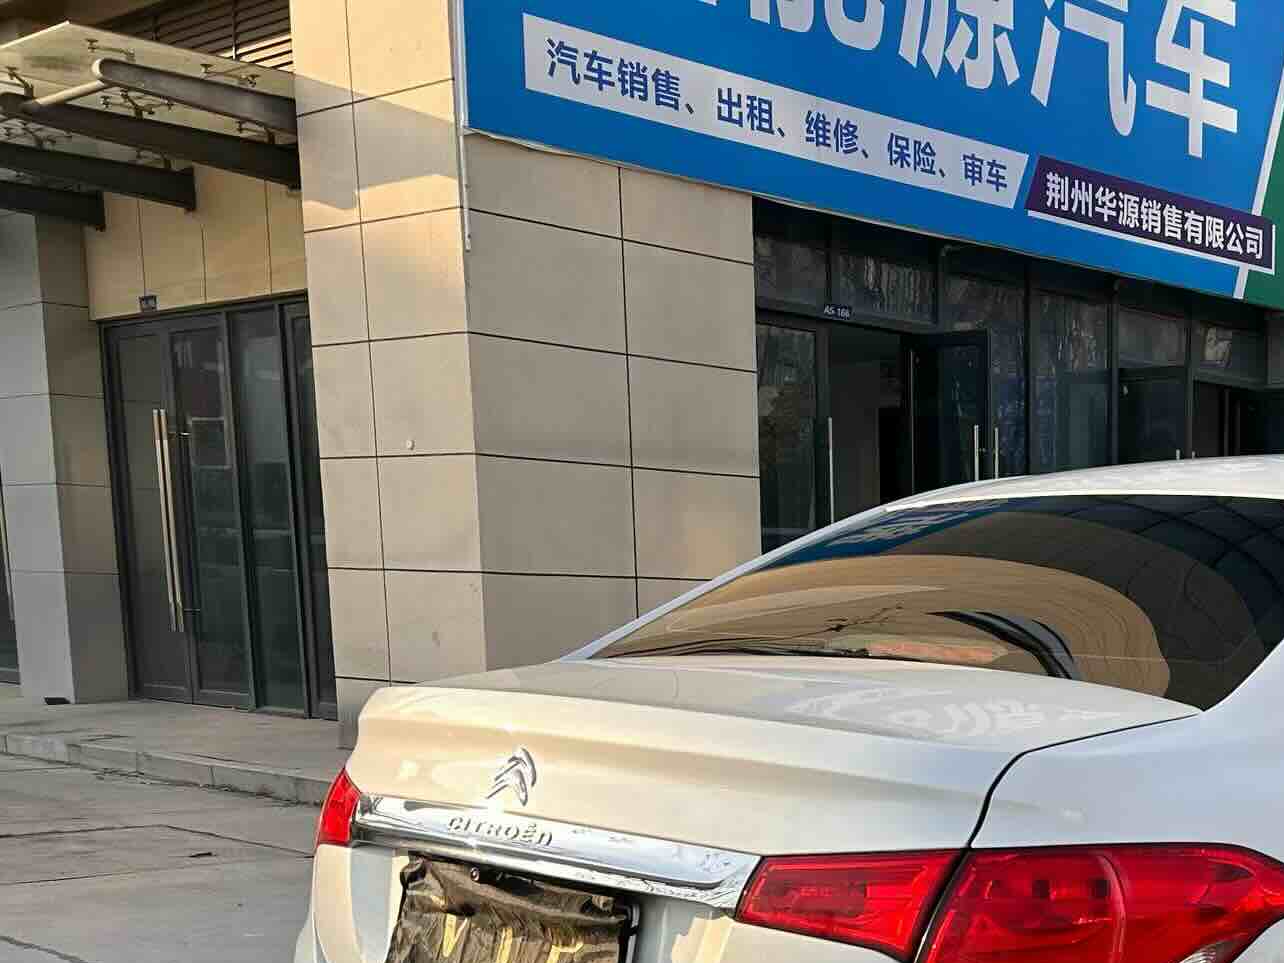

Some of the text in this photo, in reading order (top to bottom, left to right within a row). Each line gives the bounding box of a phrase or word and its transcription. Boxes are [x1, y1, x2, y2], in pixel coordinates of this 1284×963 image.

[1045, 171, 1266, 262] 荆州华源销售有限公司
